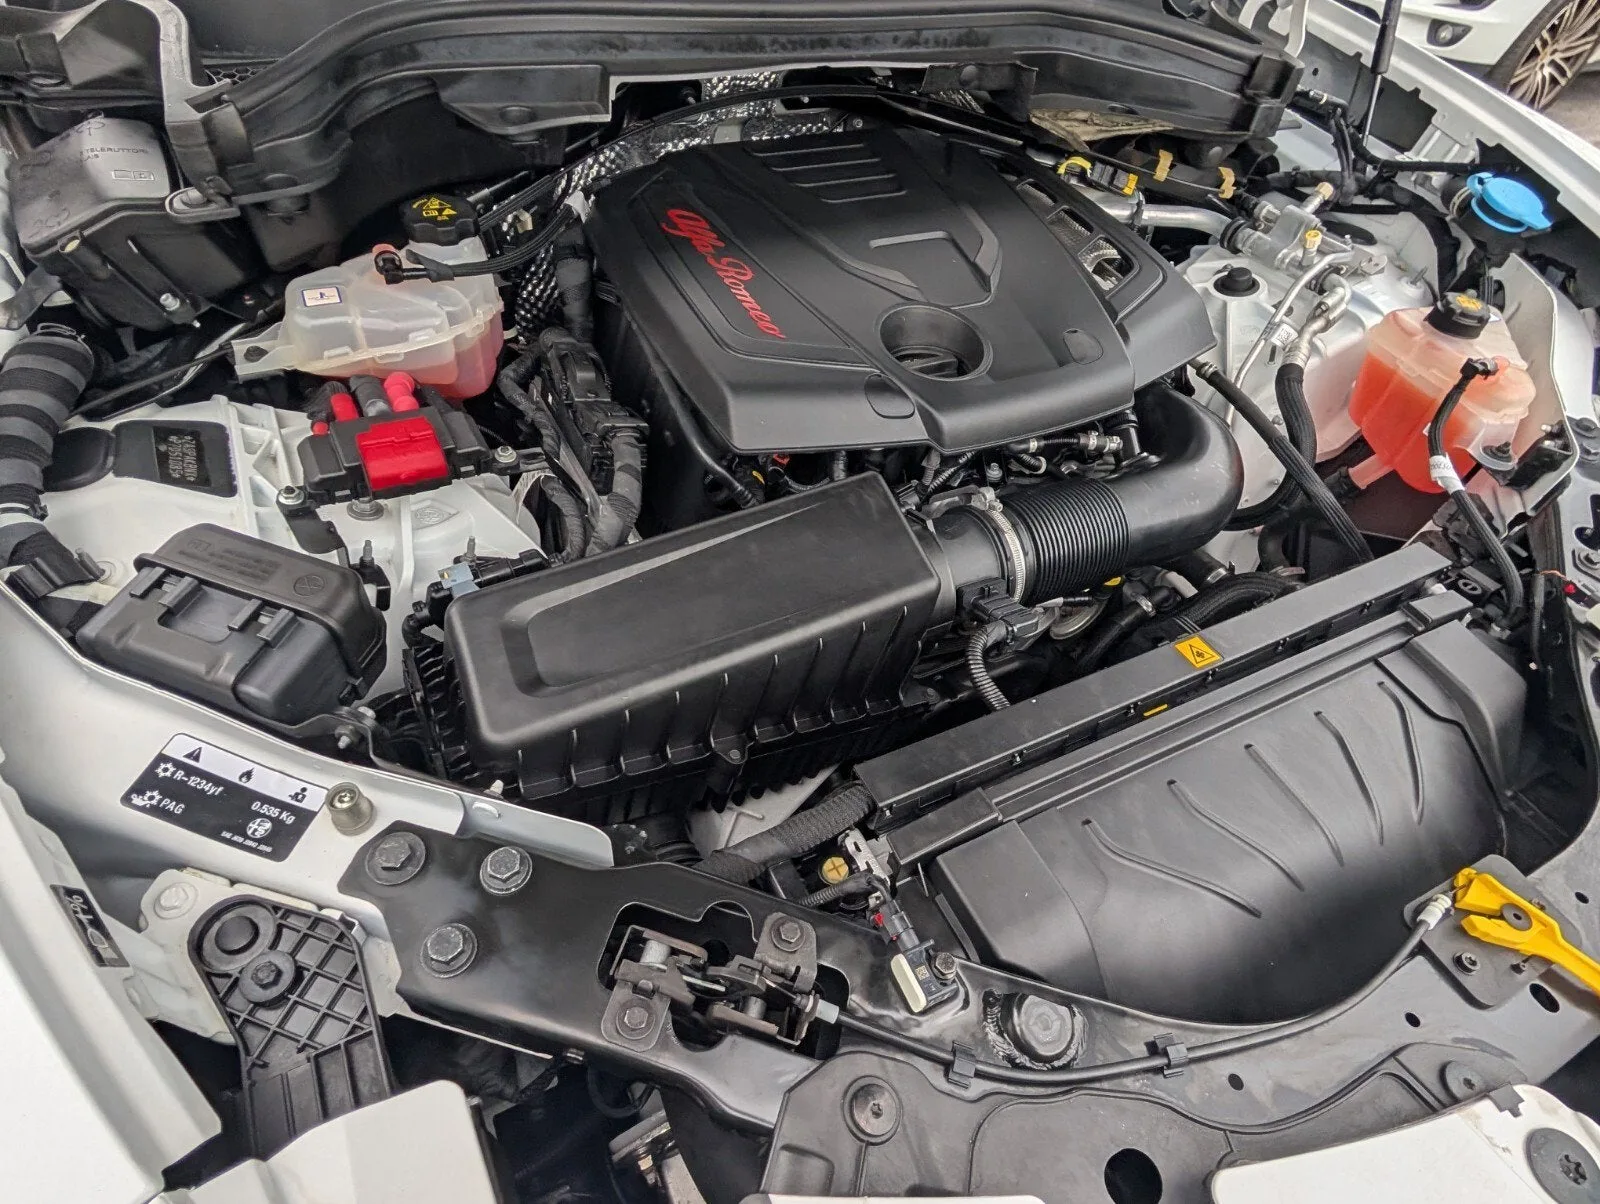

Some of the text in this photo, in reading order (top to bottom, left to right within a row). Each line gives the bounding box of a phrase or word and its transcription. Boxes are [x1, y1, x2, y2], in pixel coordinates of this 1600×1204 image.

[662, 209, 786, 339] Alfa Romeo
[173, 770, 224, 796] R-1234yf
[159, 797, 186, 815] PAG
[251, 801, 296, 825] 0.535 Kg
